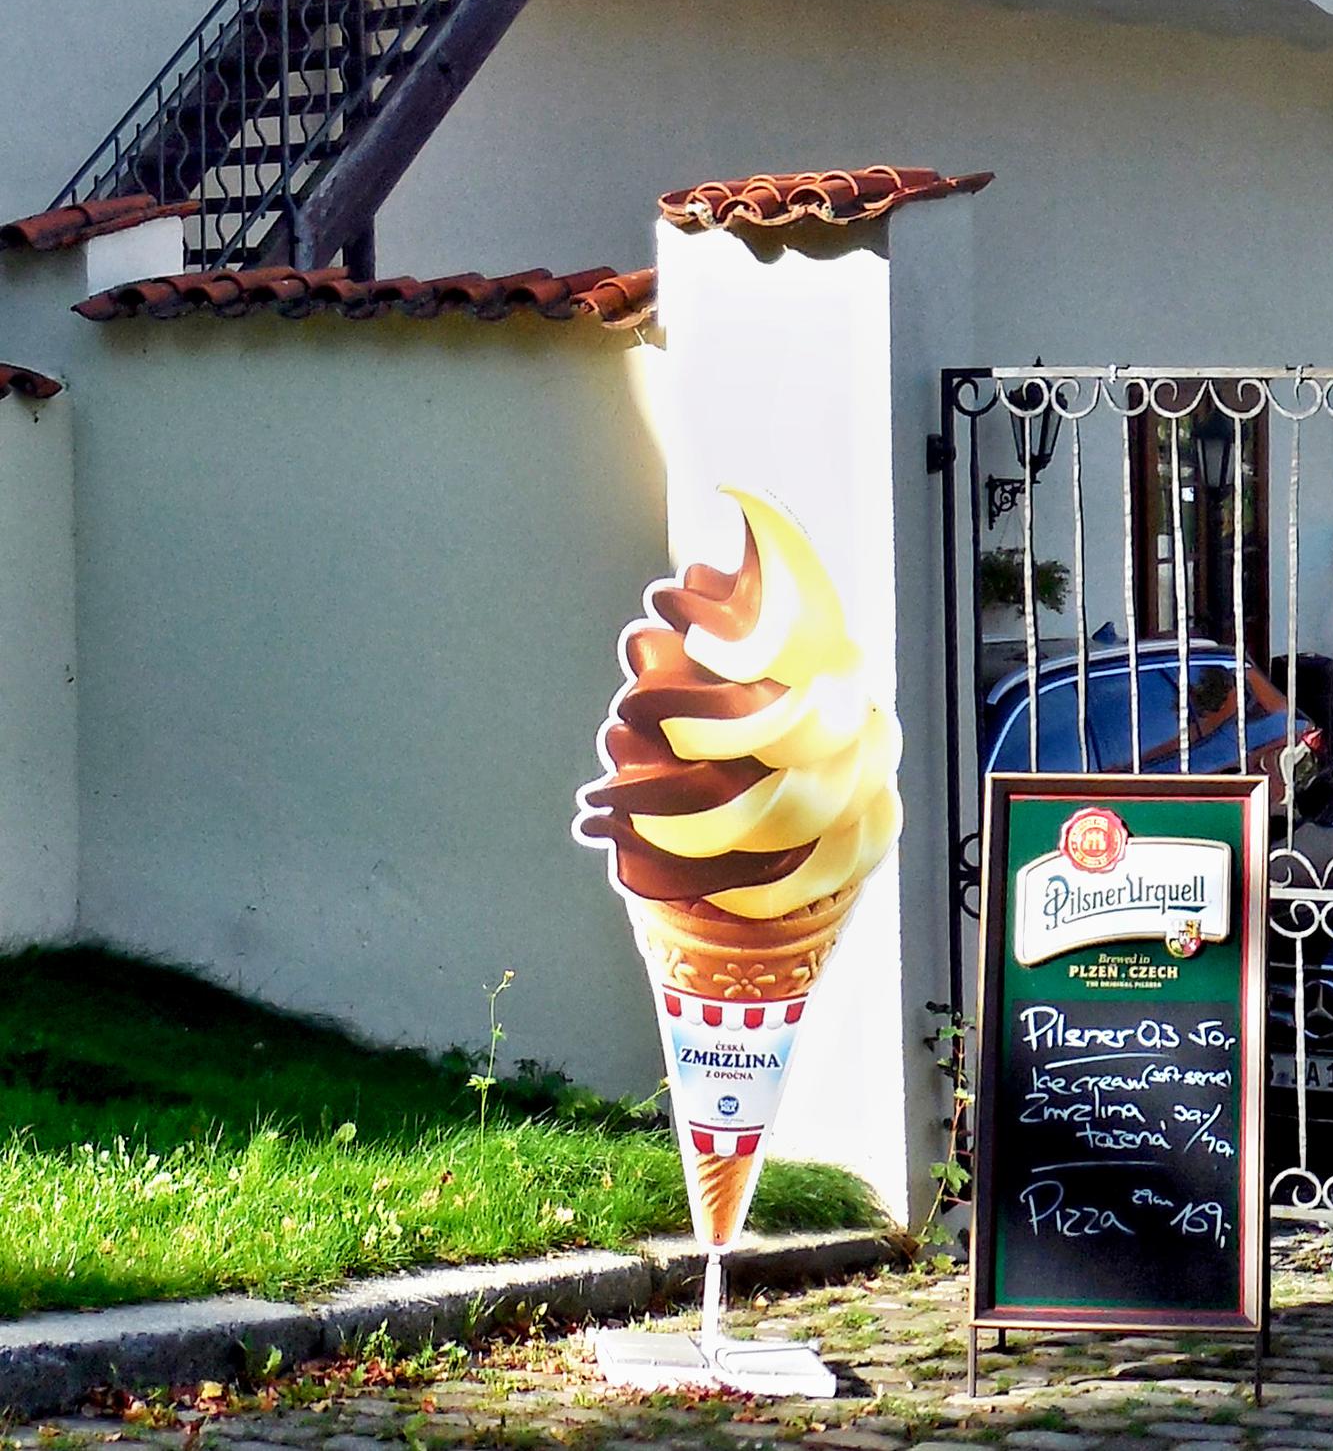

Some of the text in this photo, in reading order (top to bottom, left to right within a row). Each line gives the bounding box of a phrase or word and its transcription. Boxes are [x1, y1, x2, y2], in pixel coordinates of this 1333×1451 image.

[1043, 872, 1205, 931] Pilsner Urquell
[1098, 952, 1151, 965] Brewed in
[1128, 965, 1179, 979] CZECH
[1019, 1005, 1135, 1052] Pilsner
[680, 1047, 781, 1069] ZMRZLINA
[713, 1069, 754, 1081] OPOČNA
[1031, 1066, 1072, 1095] Ice
[1019, 1087, 1146, 1124] Zmrzlina
[1019, 1179, 1136, 1237] Pizza
